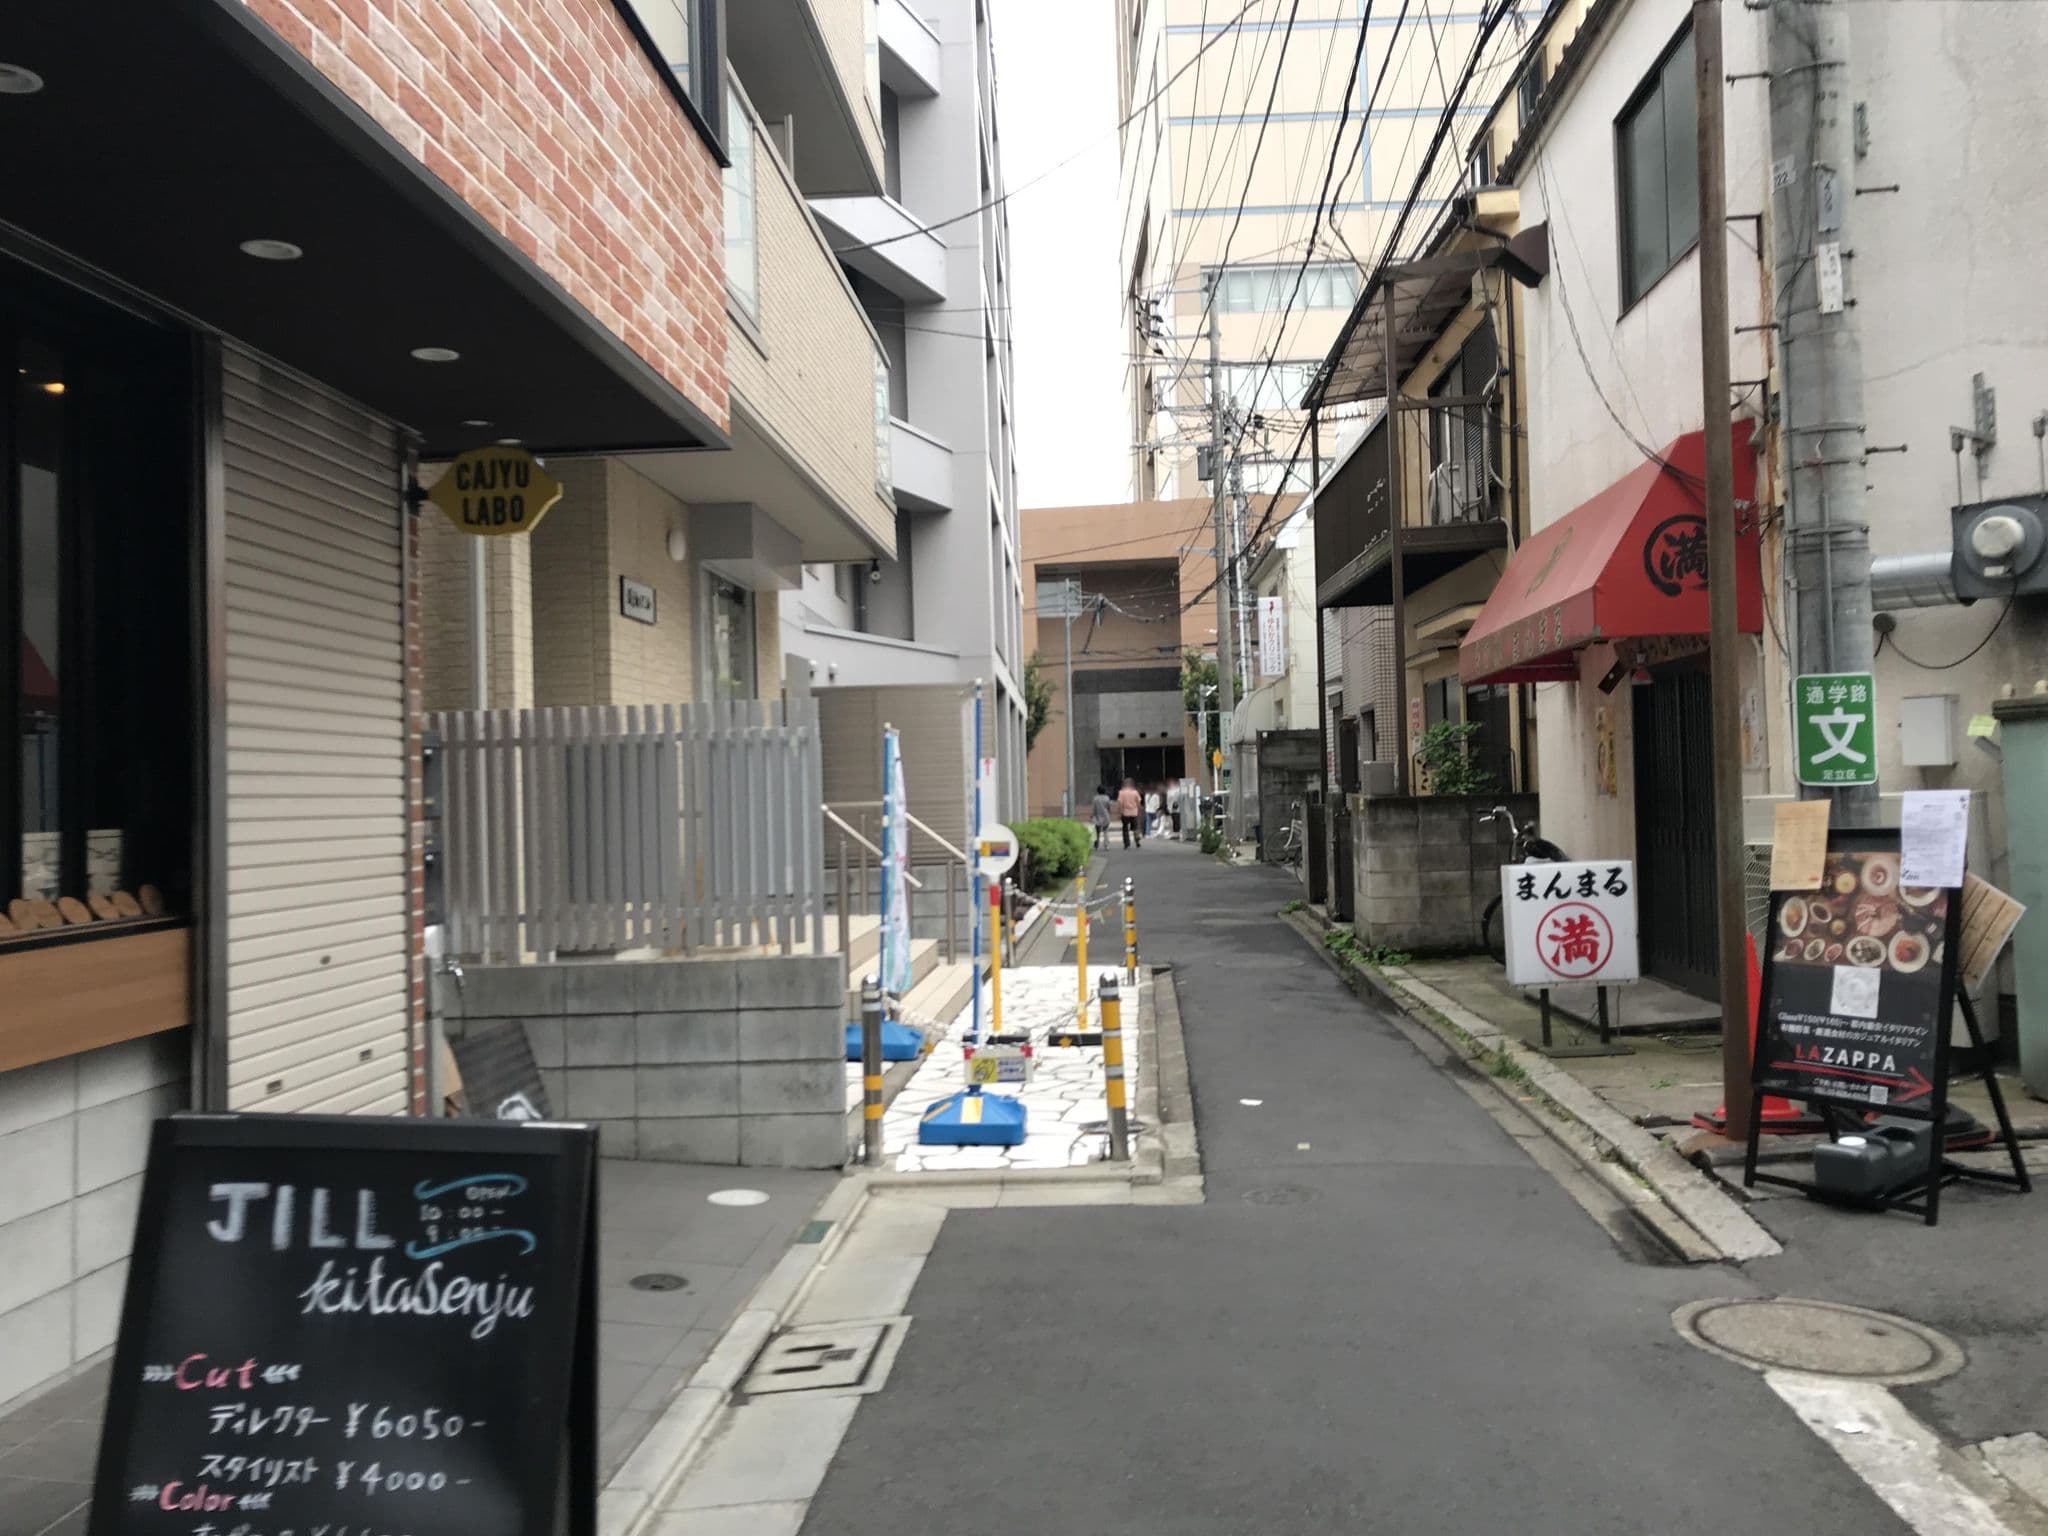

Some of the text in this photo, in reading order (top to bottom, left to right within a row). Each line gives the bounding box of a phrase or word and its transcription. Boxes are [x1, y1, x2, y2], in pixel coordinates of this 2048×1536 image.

[456, 459, 530, 490] CAJYU
[462, 495, 525, 525] LABO
[1805, 684, 1868, 704] 通学路
[1808, 706, 1867, 765] 文
[1515, 867, 1628, 901] まんまる
[1547, 913, 1600, 966] 満
[206, 1182, 398, 1251] JILL
[175, 1353, 262, 1391] Cut
[208, 1401, 332, 1437] ディレクター
[196, 1454, 320, 1487] スタイリスト
[159, 1480, 237, 1512] Color
